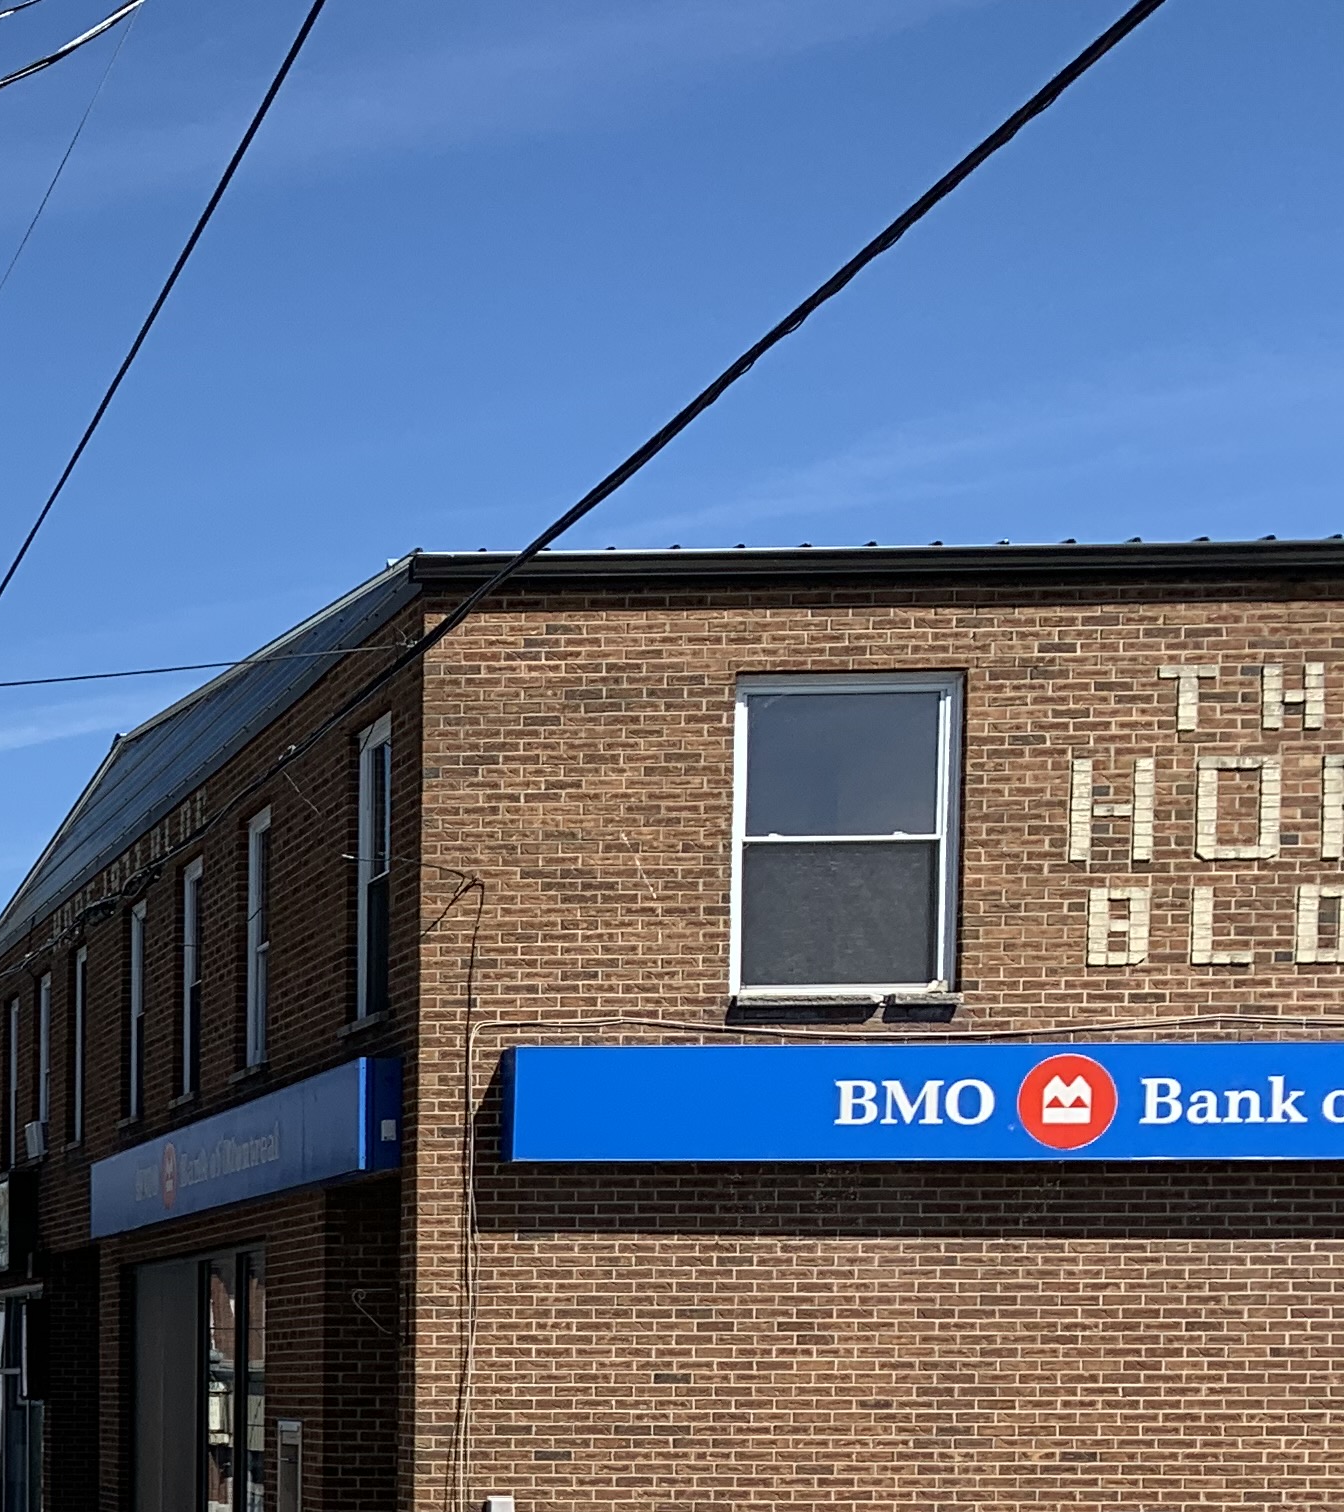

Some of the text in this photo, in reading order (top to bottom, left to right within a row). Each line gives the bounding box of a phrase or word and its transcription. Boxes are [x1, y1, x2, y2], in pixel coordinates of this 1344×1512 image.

[1069, 756, 1344, 863] HO
[834, 1079, 996, 1126] BMO
[1139, 1076, 1308, 1125] Bank
